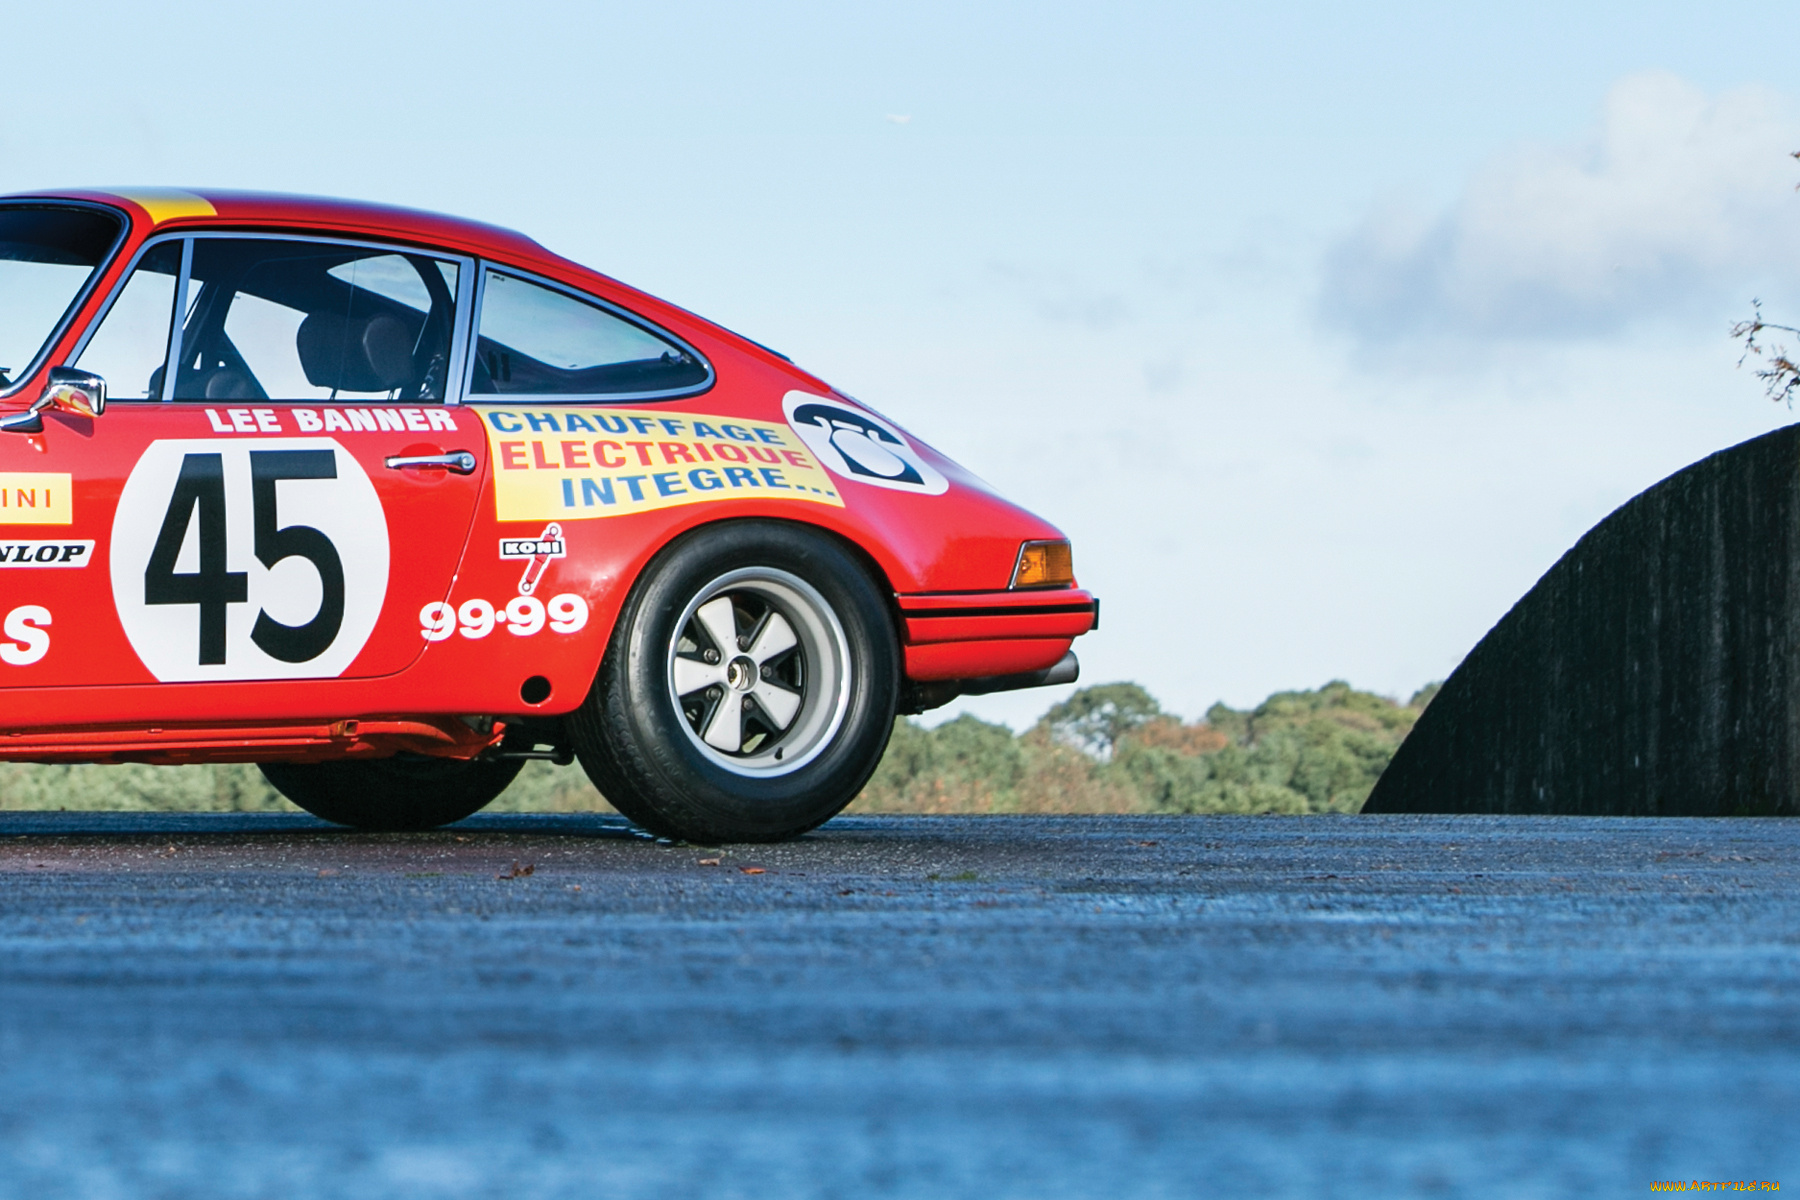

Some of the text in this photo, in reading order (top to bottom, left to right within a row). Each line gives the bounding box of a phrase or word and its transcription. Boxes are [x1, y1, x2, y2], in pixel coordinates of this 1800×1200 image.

[205, 408, 457, 432] LEE BANNER
[488, 411, 786, 446] CHAUFFAGE
[499, 440, 813, 469] ELECTRIQUE
[144, 449, 345, 666] 45
[505, 542, 561, 554] KONI
